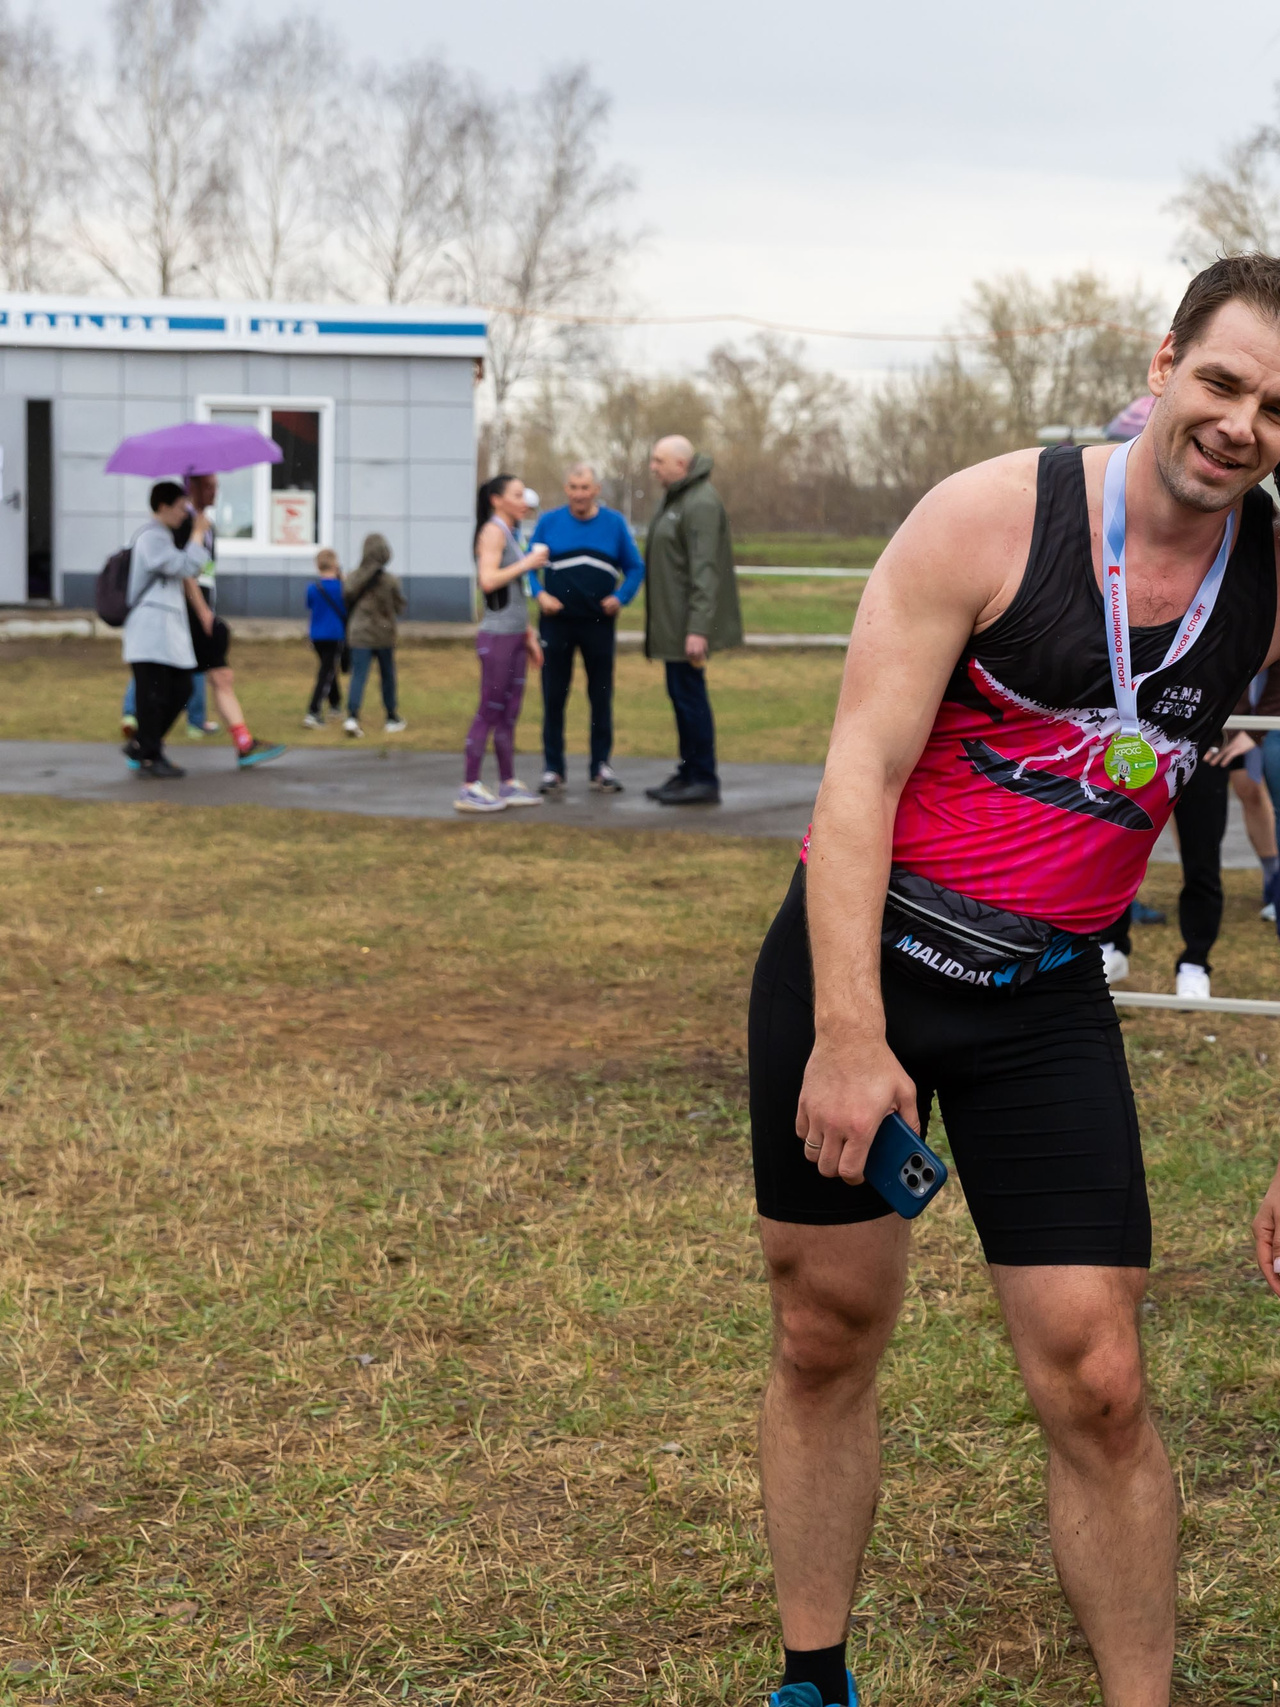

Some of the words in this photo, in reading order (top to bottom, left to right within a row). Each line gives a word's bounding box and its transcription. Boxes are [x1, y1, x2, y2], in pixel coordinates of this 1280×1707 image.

[1111, 583, 1123, 654] КАЛАШНИКОВ
[1187, 603, 1206, 632] СПОРТ
[1116, 656, 1126, 688] СПОРТ
[893, 934, 993, 987] MALIDAK
